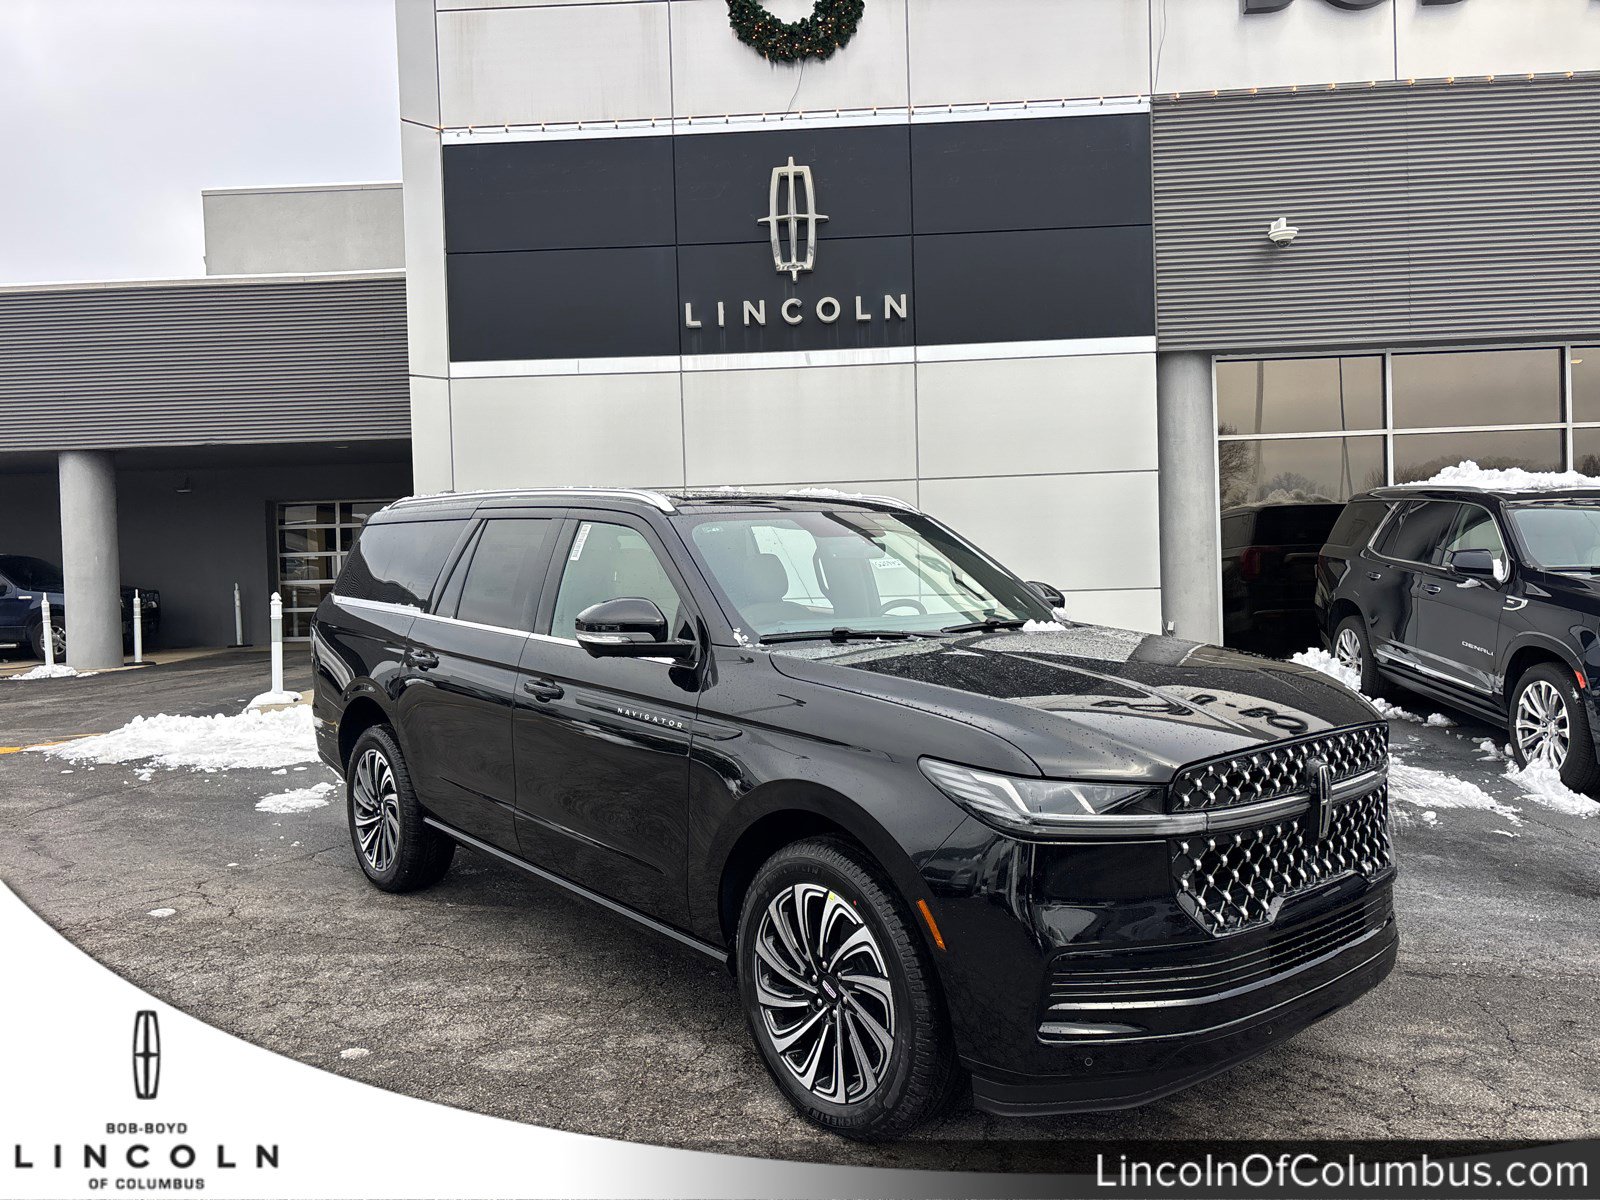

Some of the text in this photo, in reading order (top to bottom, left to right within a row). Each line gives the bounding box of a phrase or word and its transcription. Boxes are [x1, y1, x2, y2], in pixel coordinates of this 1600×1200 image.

[685, 293, 907, 328] LINCOLN
[1461, 640, 1494, 656] DENALI
[616, 707, 683, 729] NAVIGATOR
